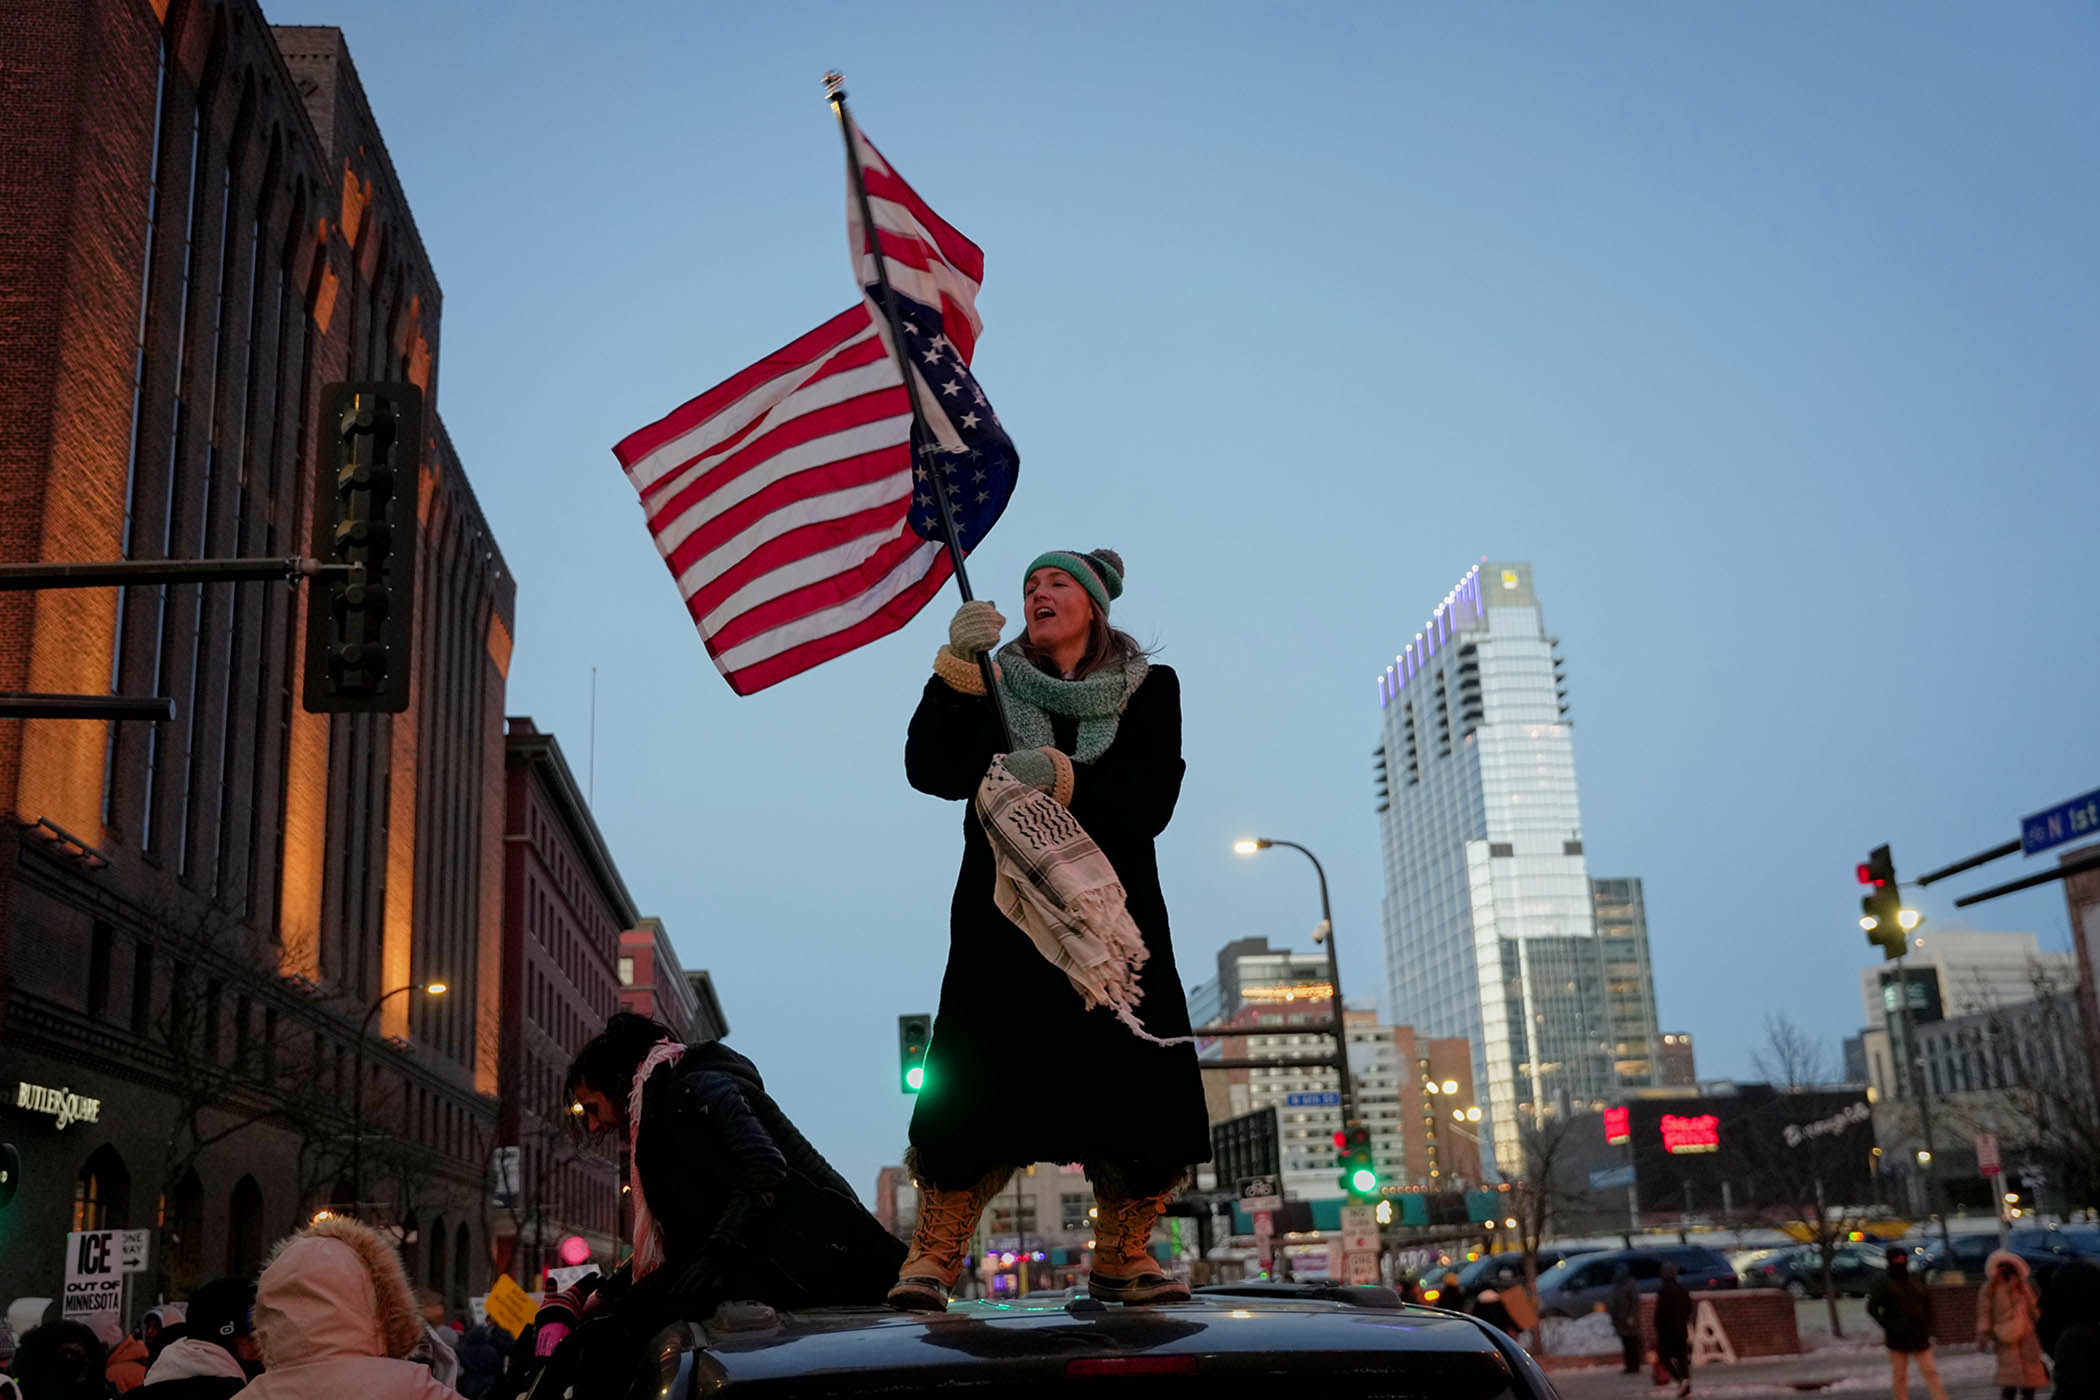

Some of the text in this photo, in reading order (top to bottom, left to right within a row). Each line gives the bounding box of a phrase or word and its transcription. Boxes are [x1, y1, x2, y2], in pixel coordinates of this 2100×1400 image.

[2048, 814, 2062, 841] N
[77, 1233, 113, 1275] ICE
[67, 1280, 121, 1292] OUT OF
[65, 1292, 120, 1312] MINNESOTA
